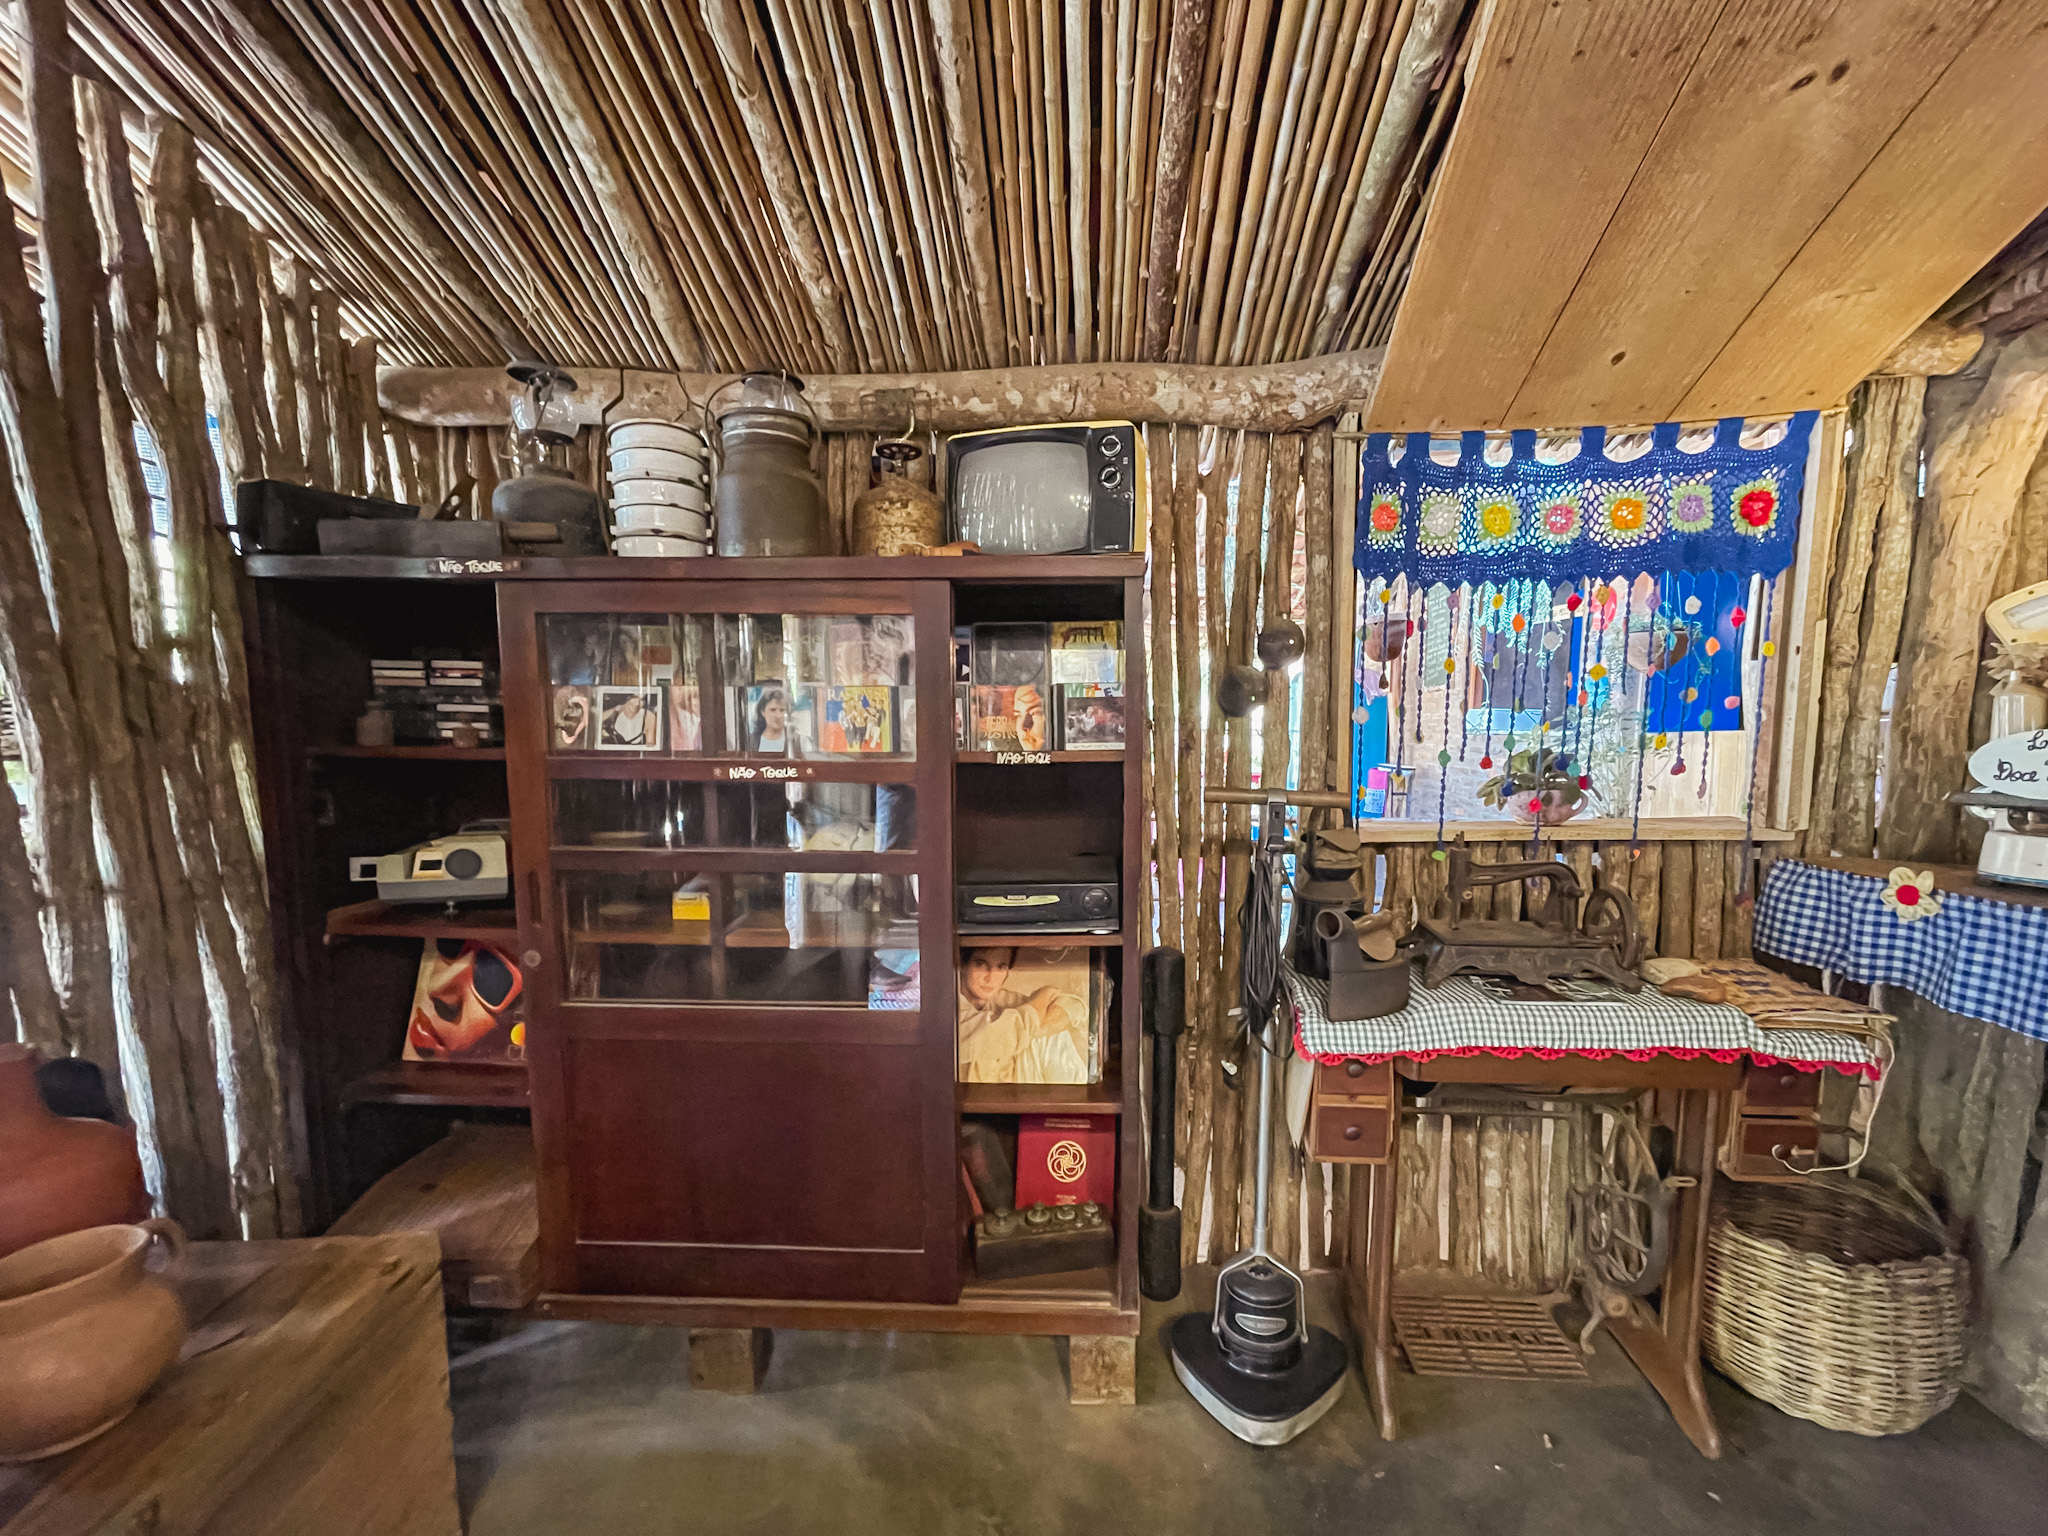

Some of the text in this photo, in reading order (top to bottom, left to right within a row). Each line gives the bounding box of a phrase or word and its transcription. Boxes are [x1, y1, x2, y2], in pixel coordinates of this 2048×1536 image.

[465, 560, 504, 574] TOQUE
[1022, 751, 1051, 765] TOQUE
[728, 766, 799, 780] NÃO TOQUE
